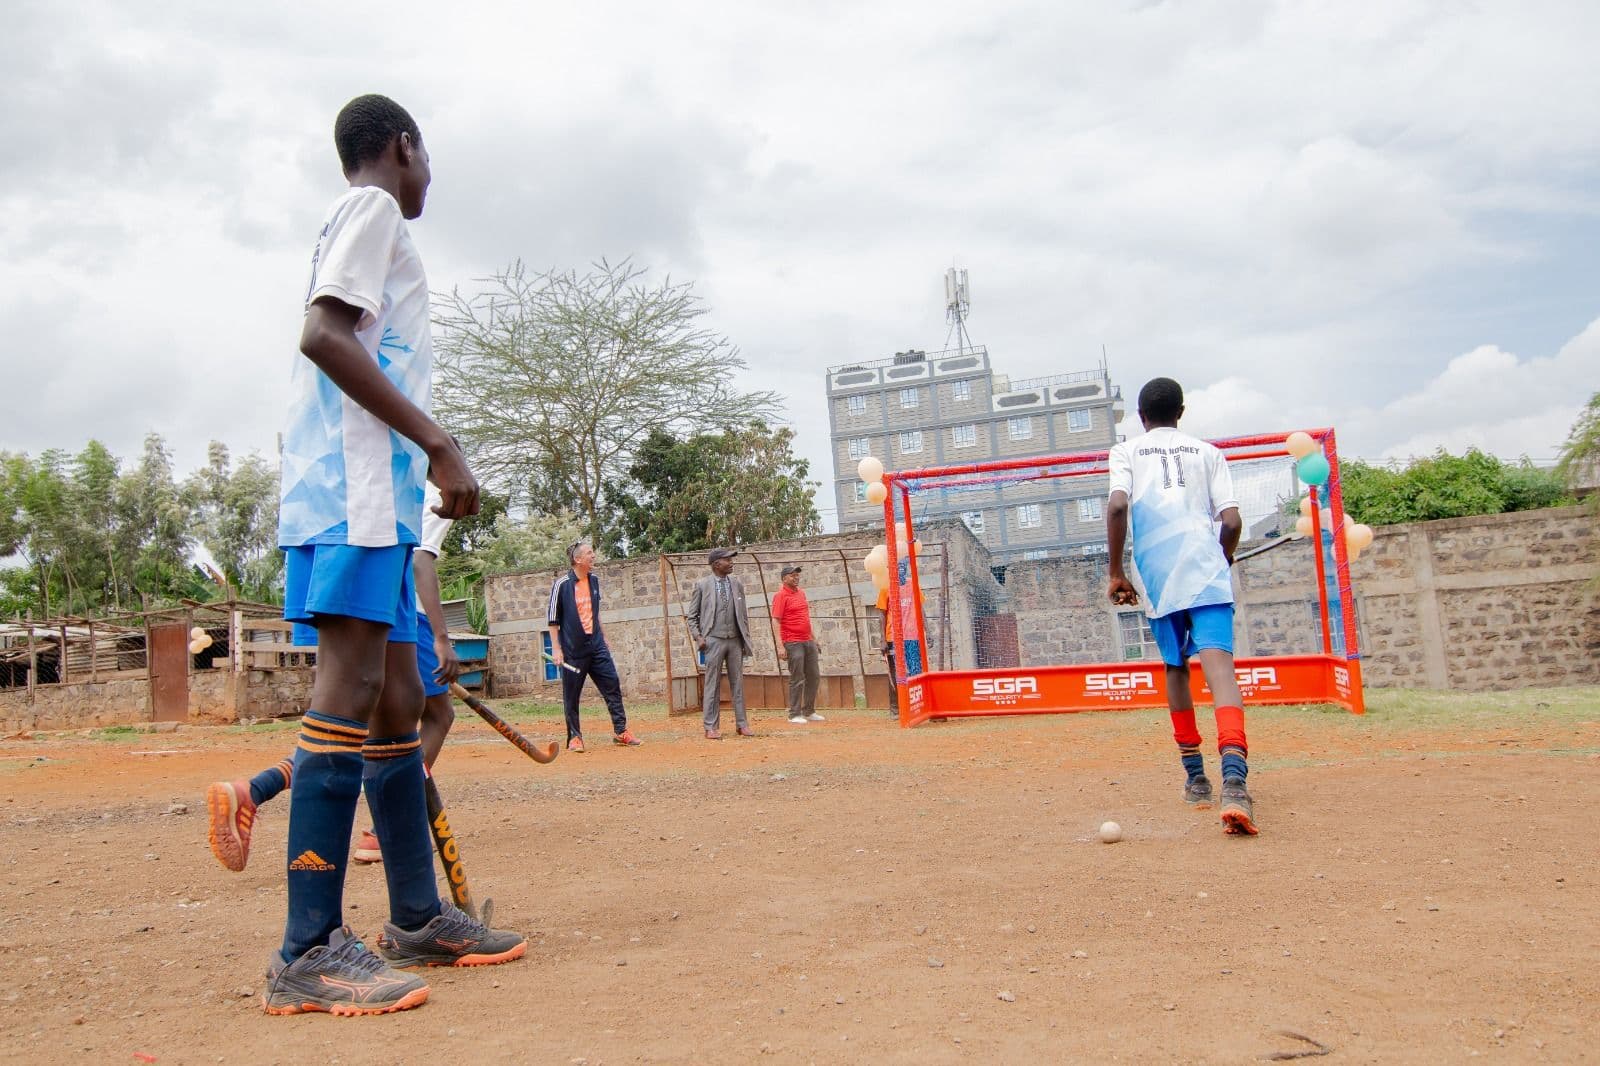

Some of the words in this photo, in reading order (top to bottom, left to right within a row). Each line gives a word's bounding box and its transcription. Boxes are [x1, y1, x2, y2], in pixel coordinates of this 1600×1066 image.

[1139, 447, 1168, 456] OBAMA
[1169, 445, 1200, 455] HOCKEY
[1161, 455, 1186, 489] 11
[1085, 672, 1153, 690] SGA
[1234, 666, 1277, 686] GA
[973, 677, 1037, 695] SGA
[290, 863, 336, 871] adidas
